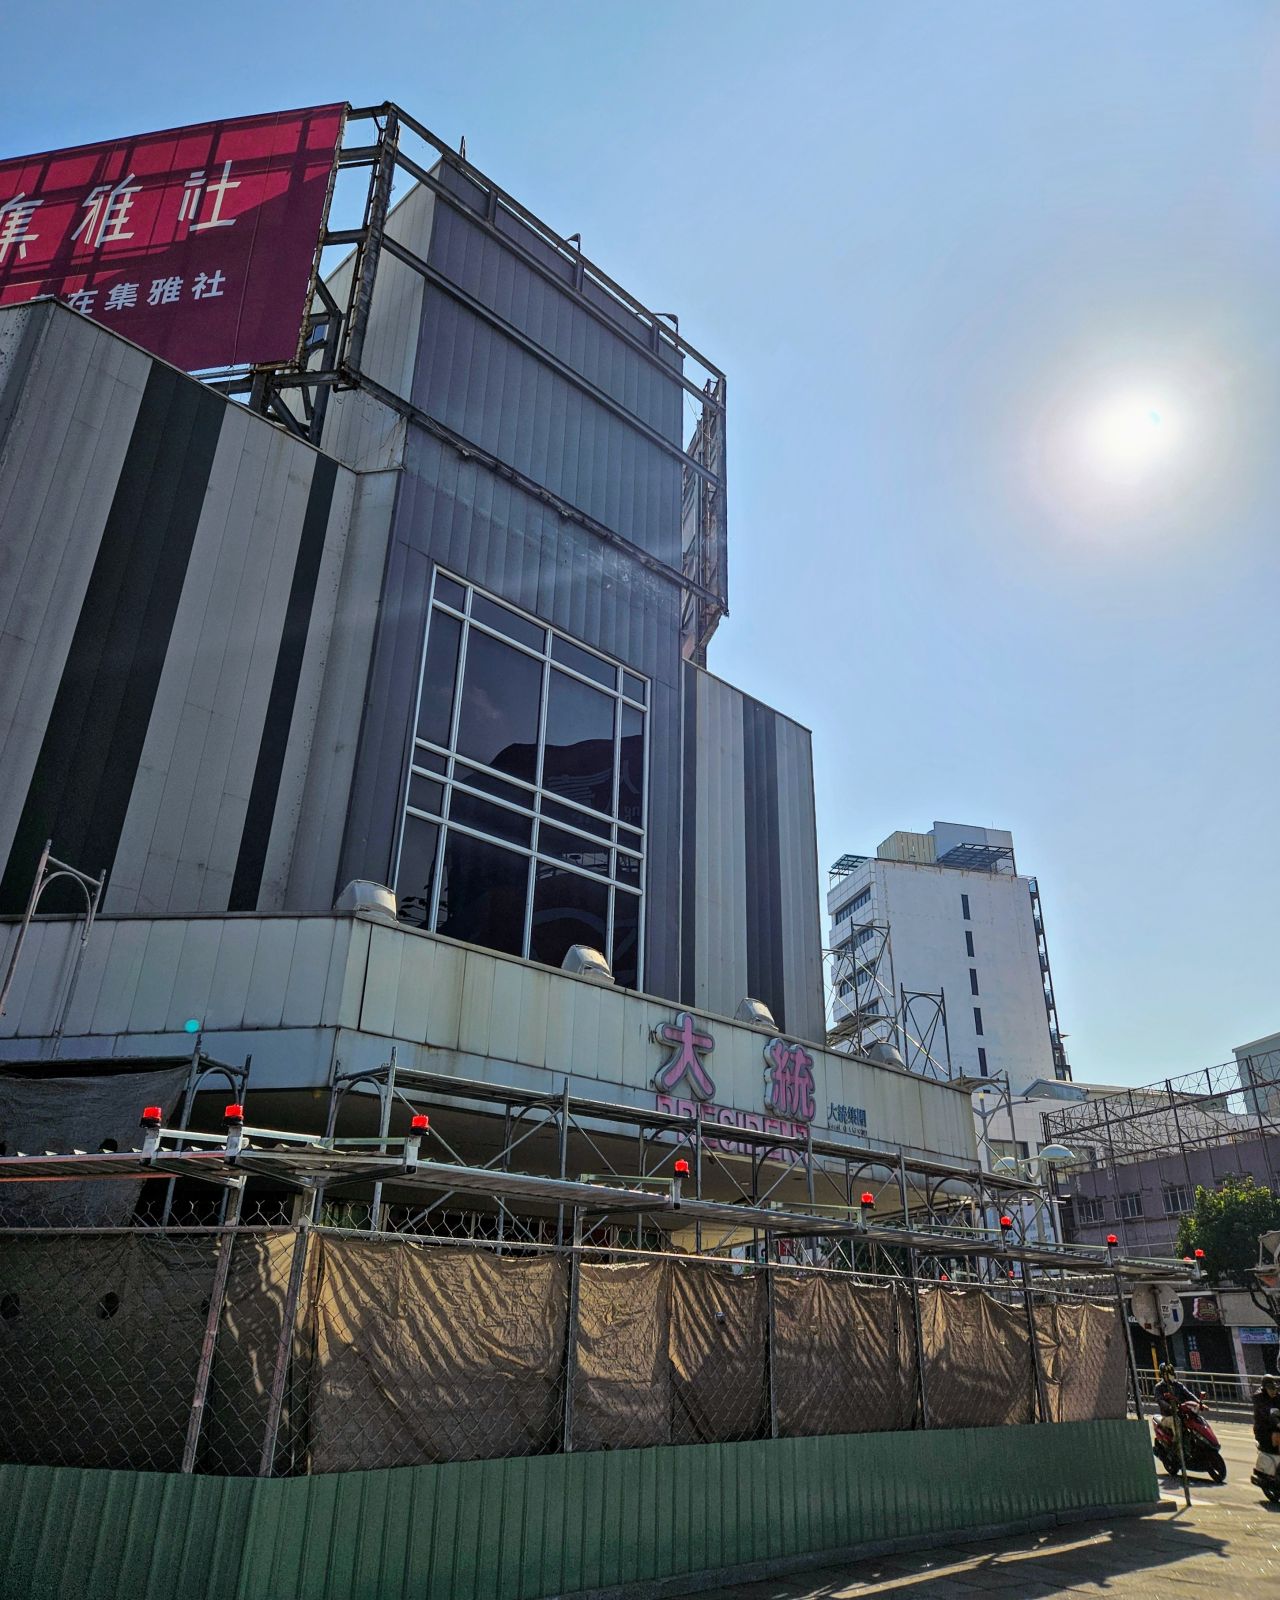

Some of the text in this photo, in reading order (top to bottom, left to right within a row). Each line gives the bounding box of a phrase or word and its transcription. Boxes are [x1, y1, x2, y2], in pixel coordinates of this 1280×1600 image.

[0, 159, 242, 263] 集雅社
[30, 269, 227, 314] 在集雅社
[654, 1011, 816, 1122] 大統
